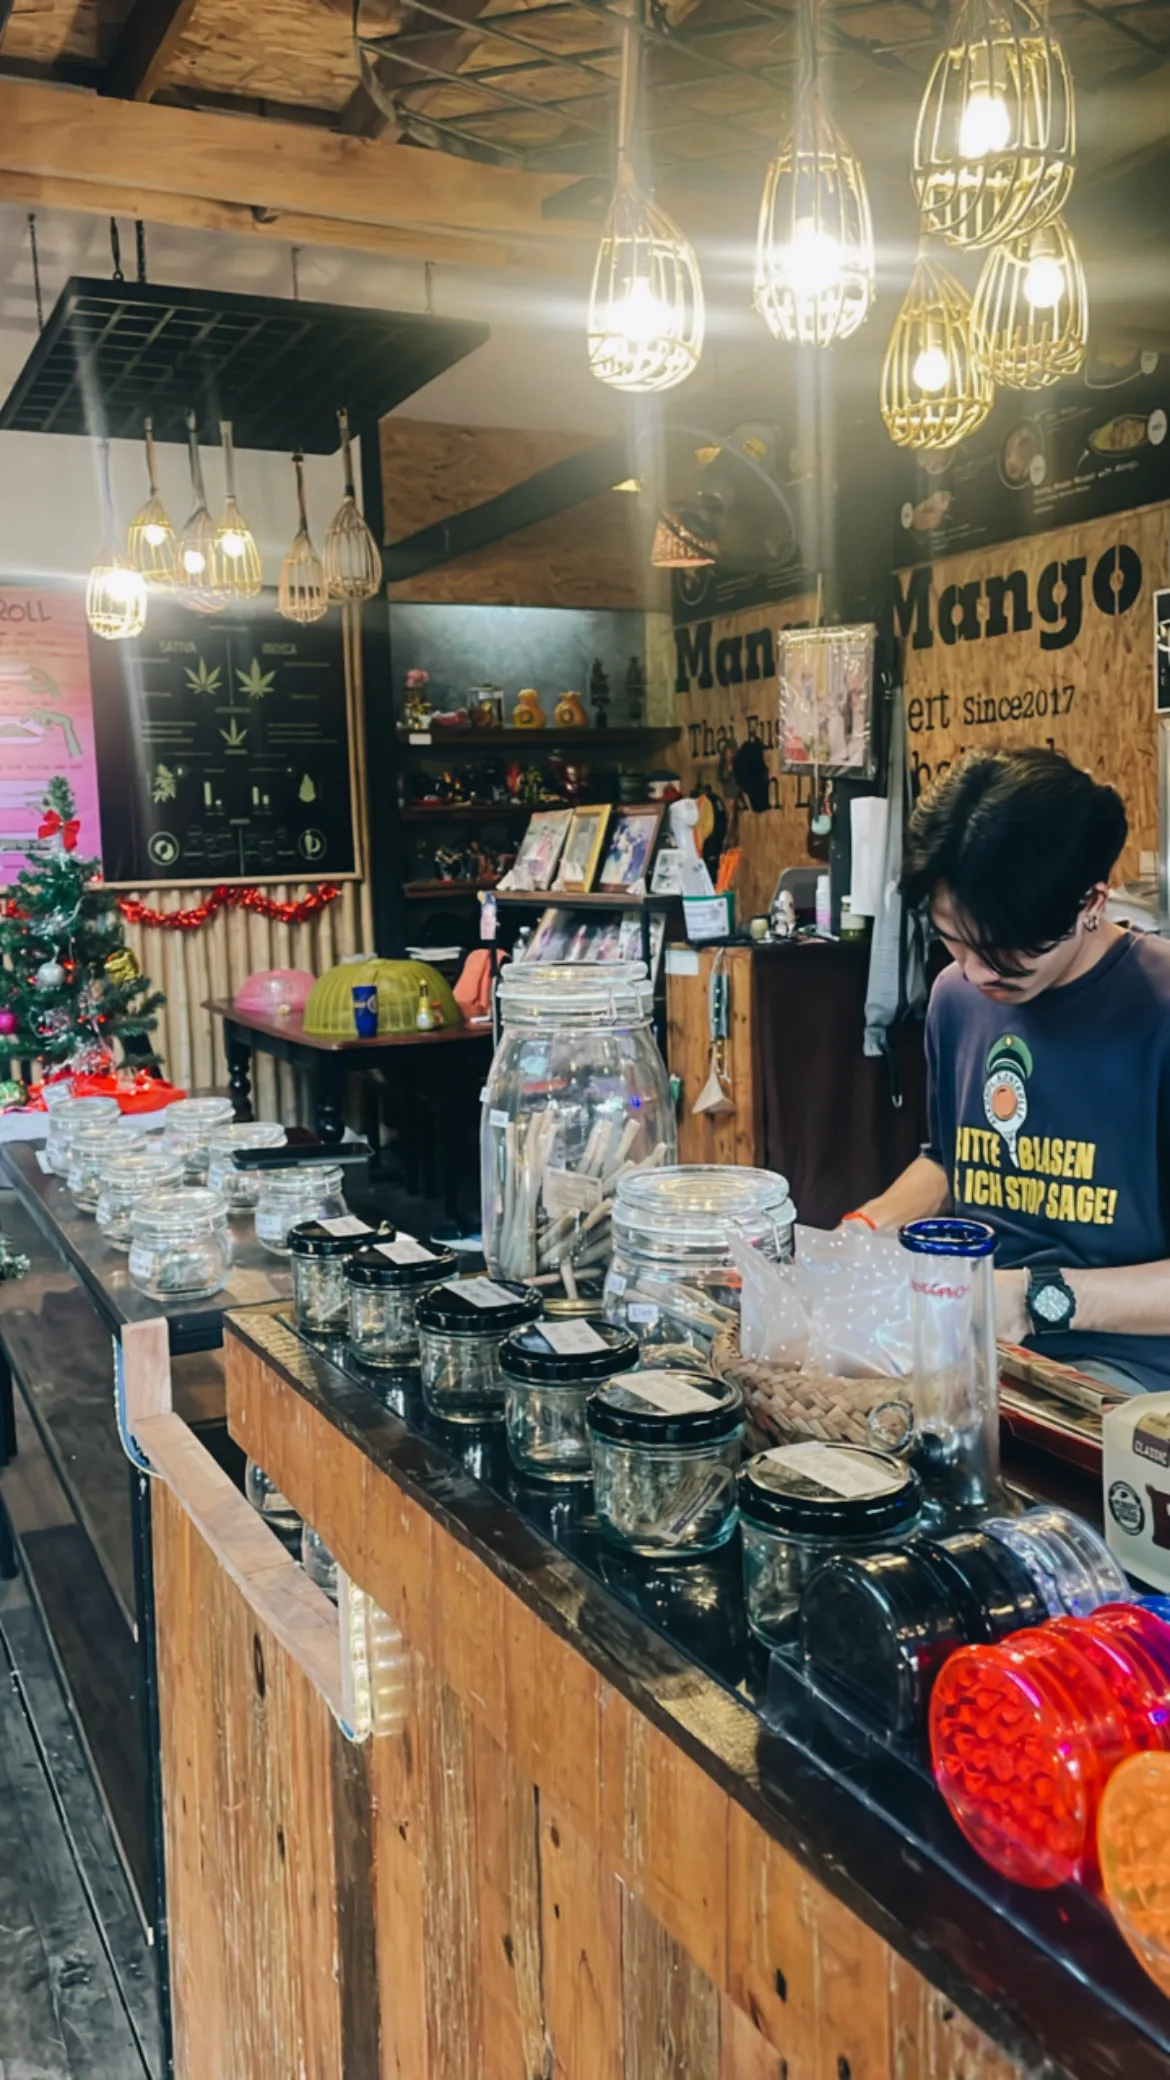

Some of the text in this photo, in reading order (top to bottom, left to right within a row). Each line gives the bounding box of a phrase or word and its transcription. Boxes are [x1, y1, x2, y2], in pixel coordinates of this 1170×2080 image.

[891, 544, 1142, 651] Mango
[963, 685, 1075, 725] since2017
[1018, 1136, 1096, 1180] BLASEN
[964, 1168, 1004, 1208] ICH
[1004, 1175, 1046, 1216] STOP
[1045, 1181, 1118, 1225] SAGE!
